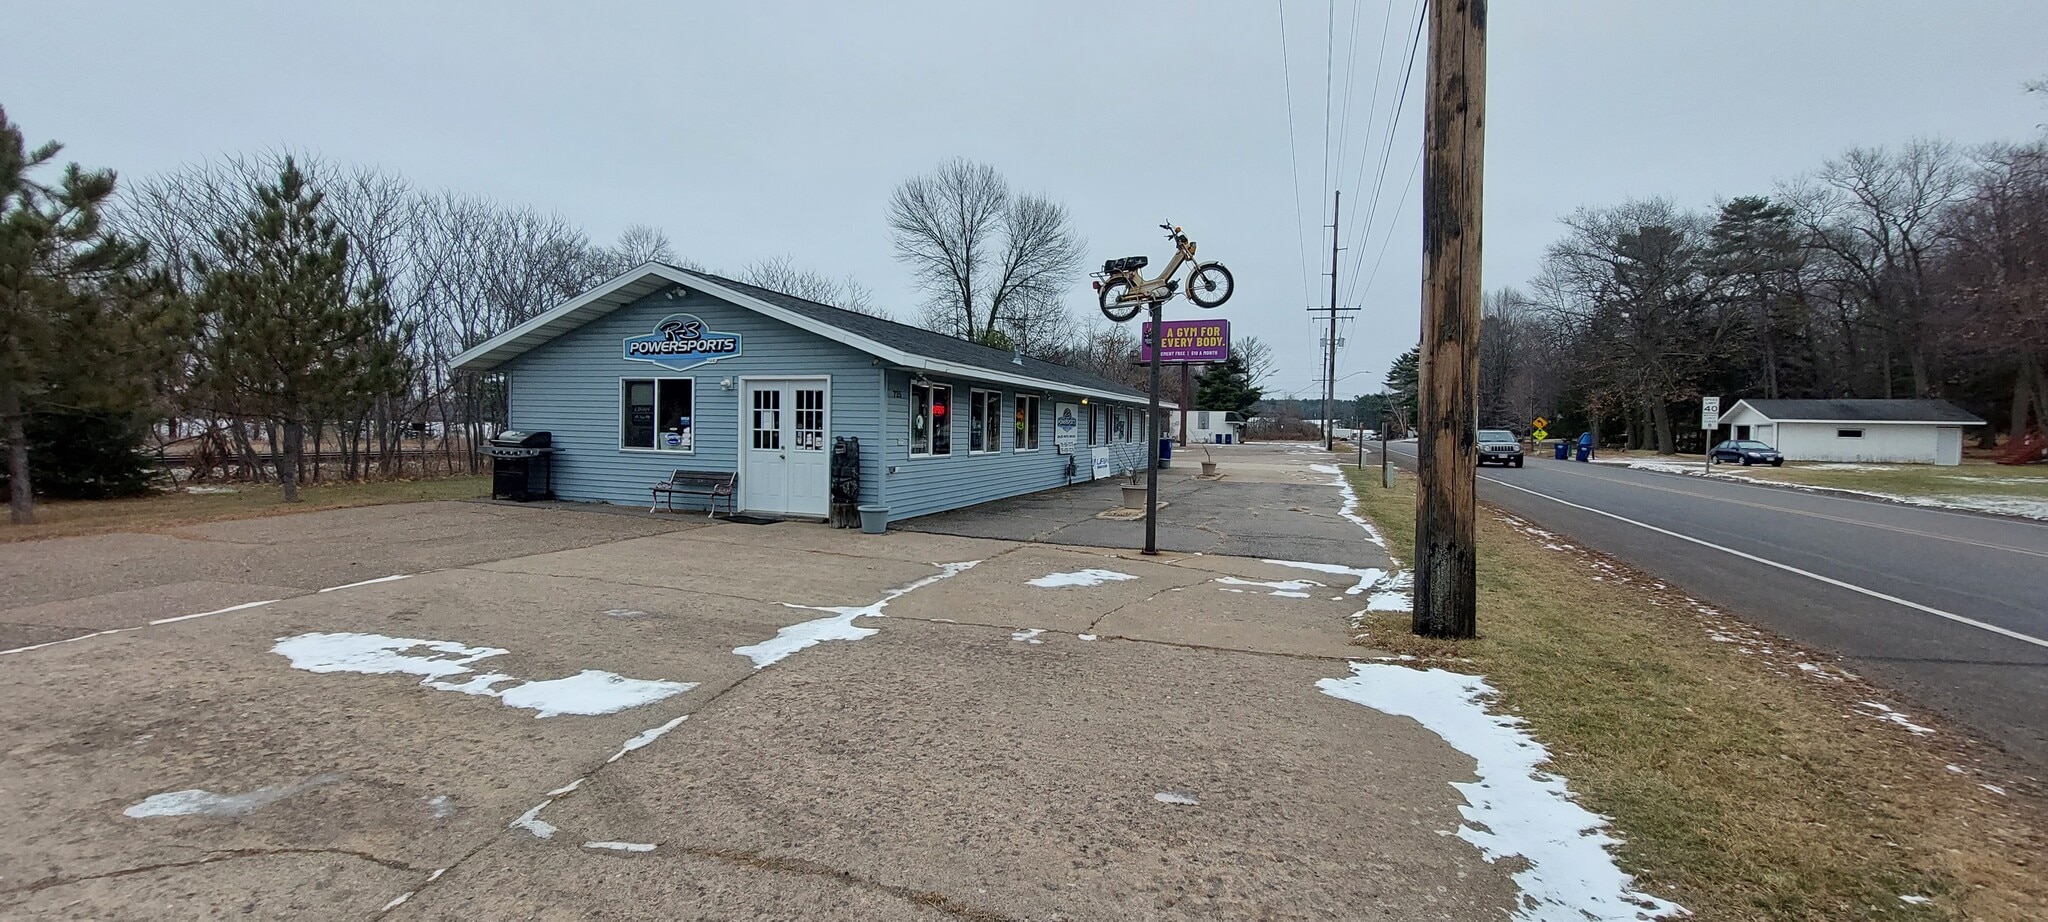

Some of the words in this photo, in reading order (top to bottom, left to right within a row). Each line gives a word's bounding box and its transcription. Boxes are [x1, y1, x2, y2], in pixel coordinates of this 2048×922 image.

[1167, 328, 1173, 337] A
[1176, 327, 1197, 337] GYM
[1200, 326, 1220, 336] FOR
[630, 339, 734, 353] POWERSPORTS
[1161, 337, 1193, 348] EVERY
[1196, 336, 1226, 347] BODY.
